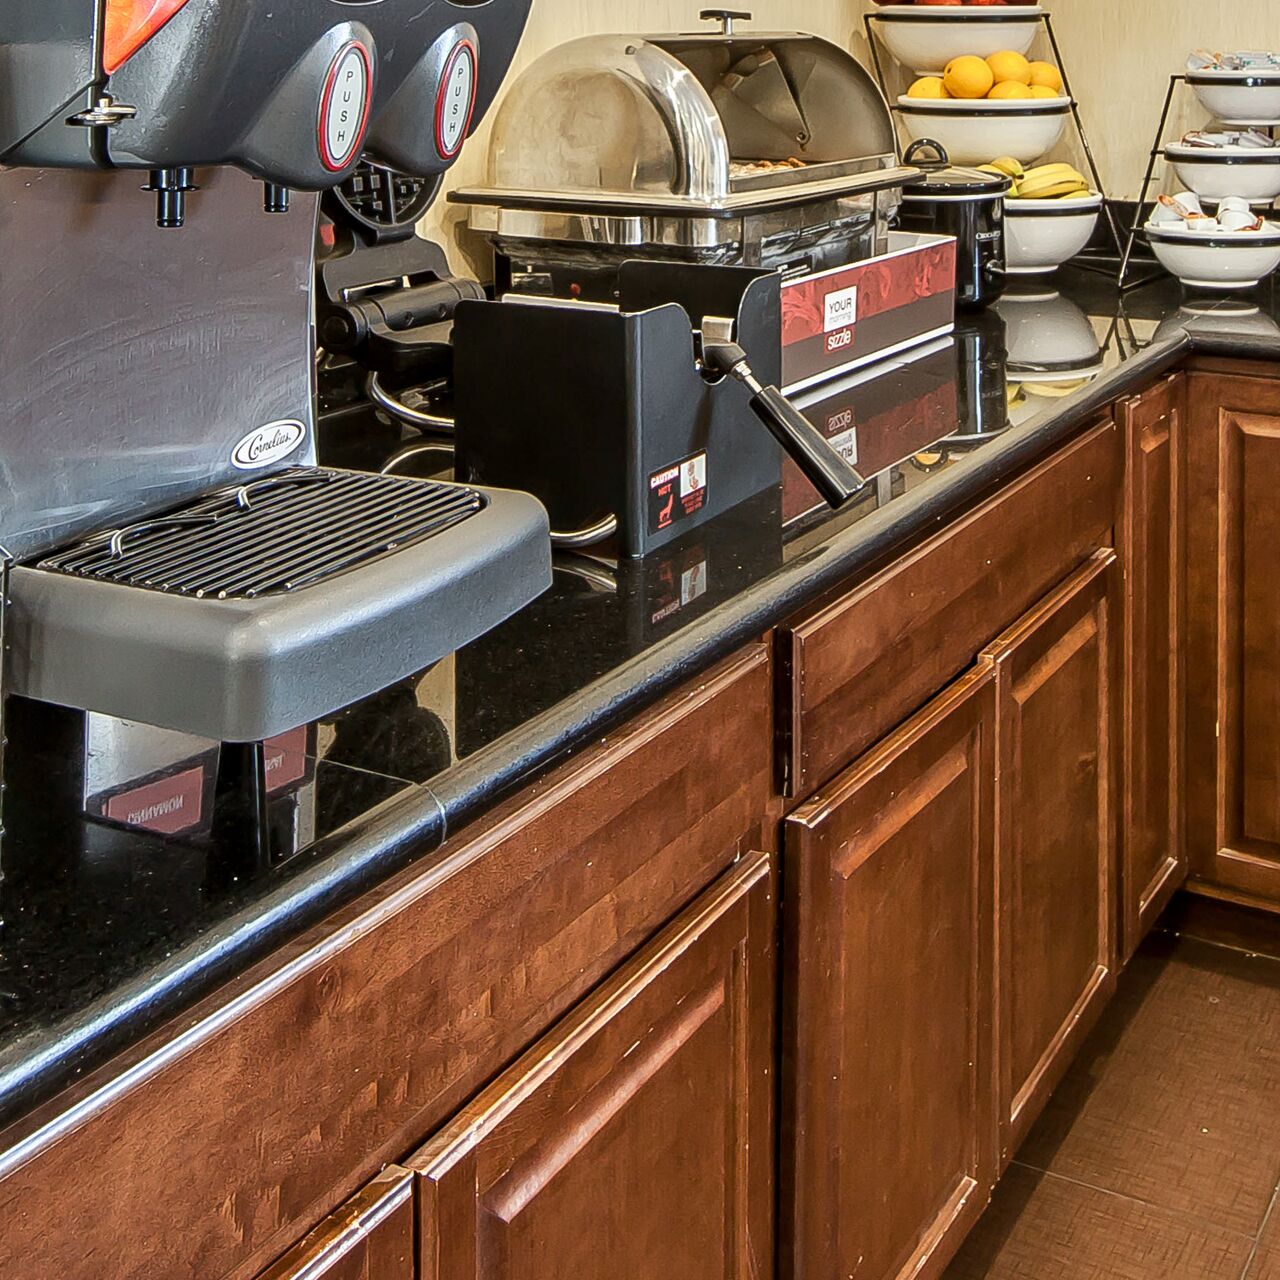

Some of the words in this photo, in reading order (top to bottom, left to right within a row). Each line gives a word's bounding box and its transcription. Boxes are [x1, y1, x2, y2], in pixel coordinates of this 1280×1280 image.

[336, 71, 354, 143] PUSH
[449, 67, 464, 133] PUSH
[828, 297, 852, 314] YOUR
[827, 328, 851, 351] sizzle
[650, 465, 679, 490] CAUTION
